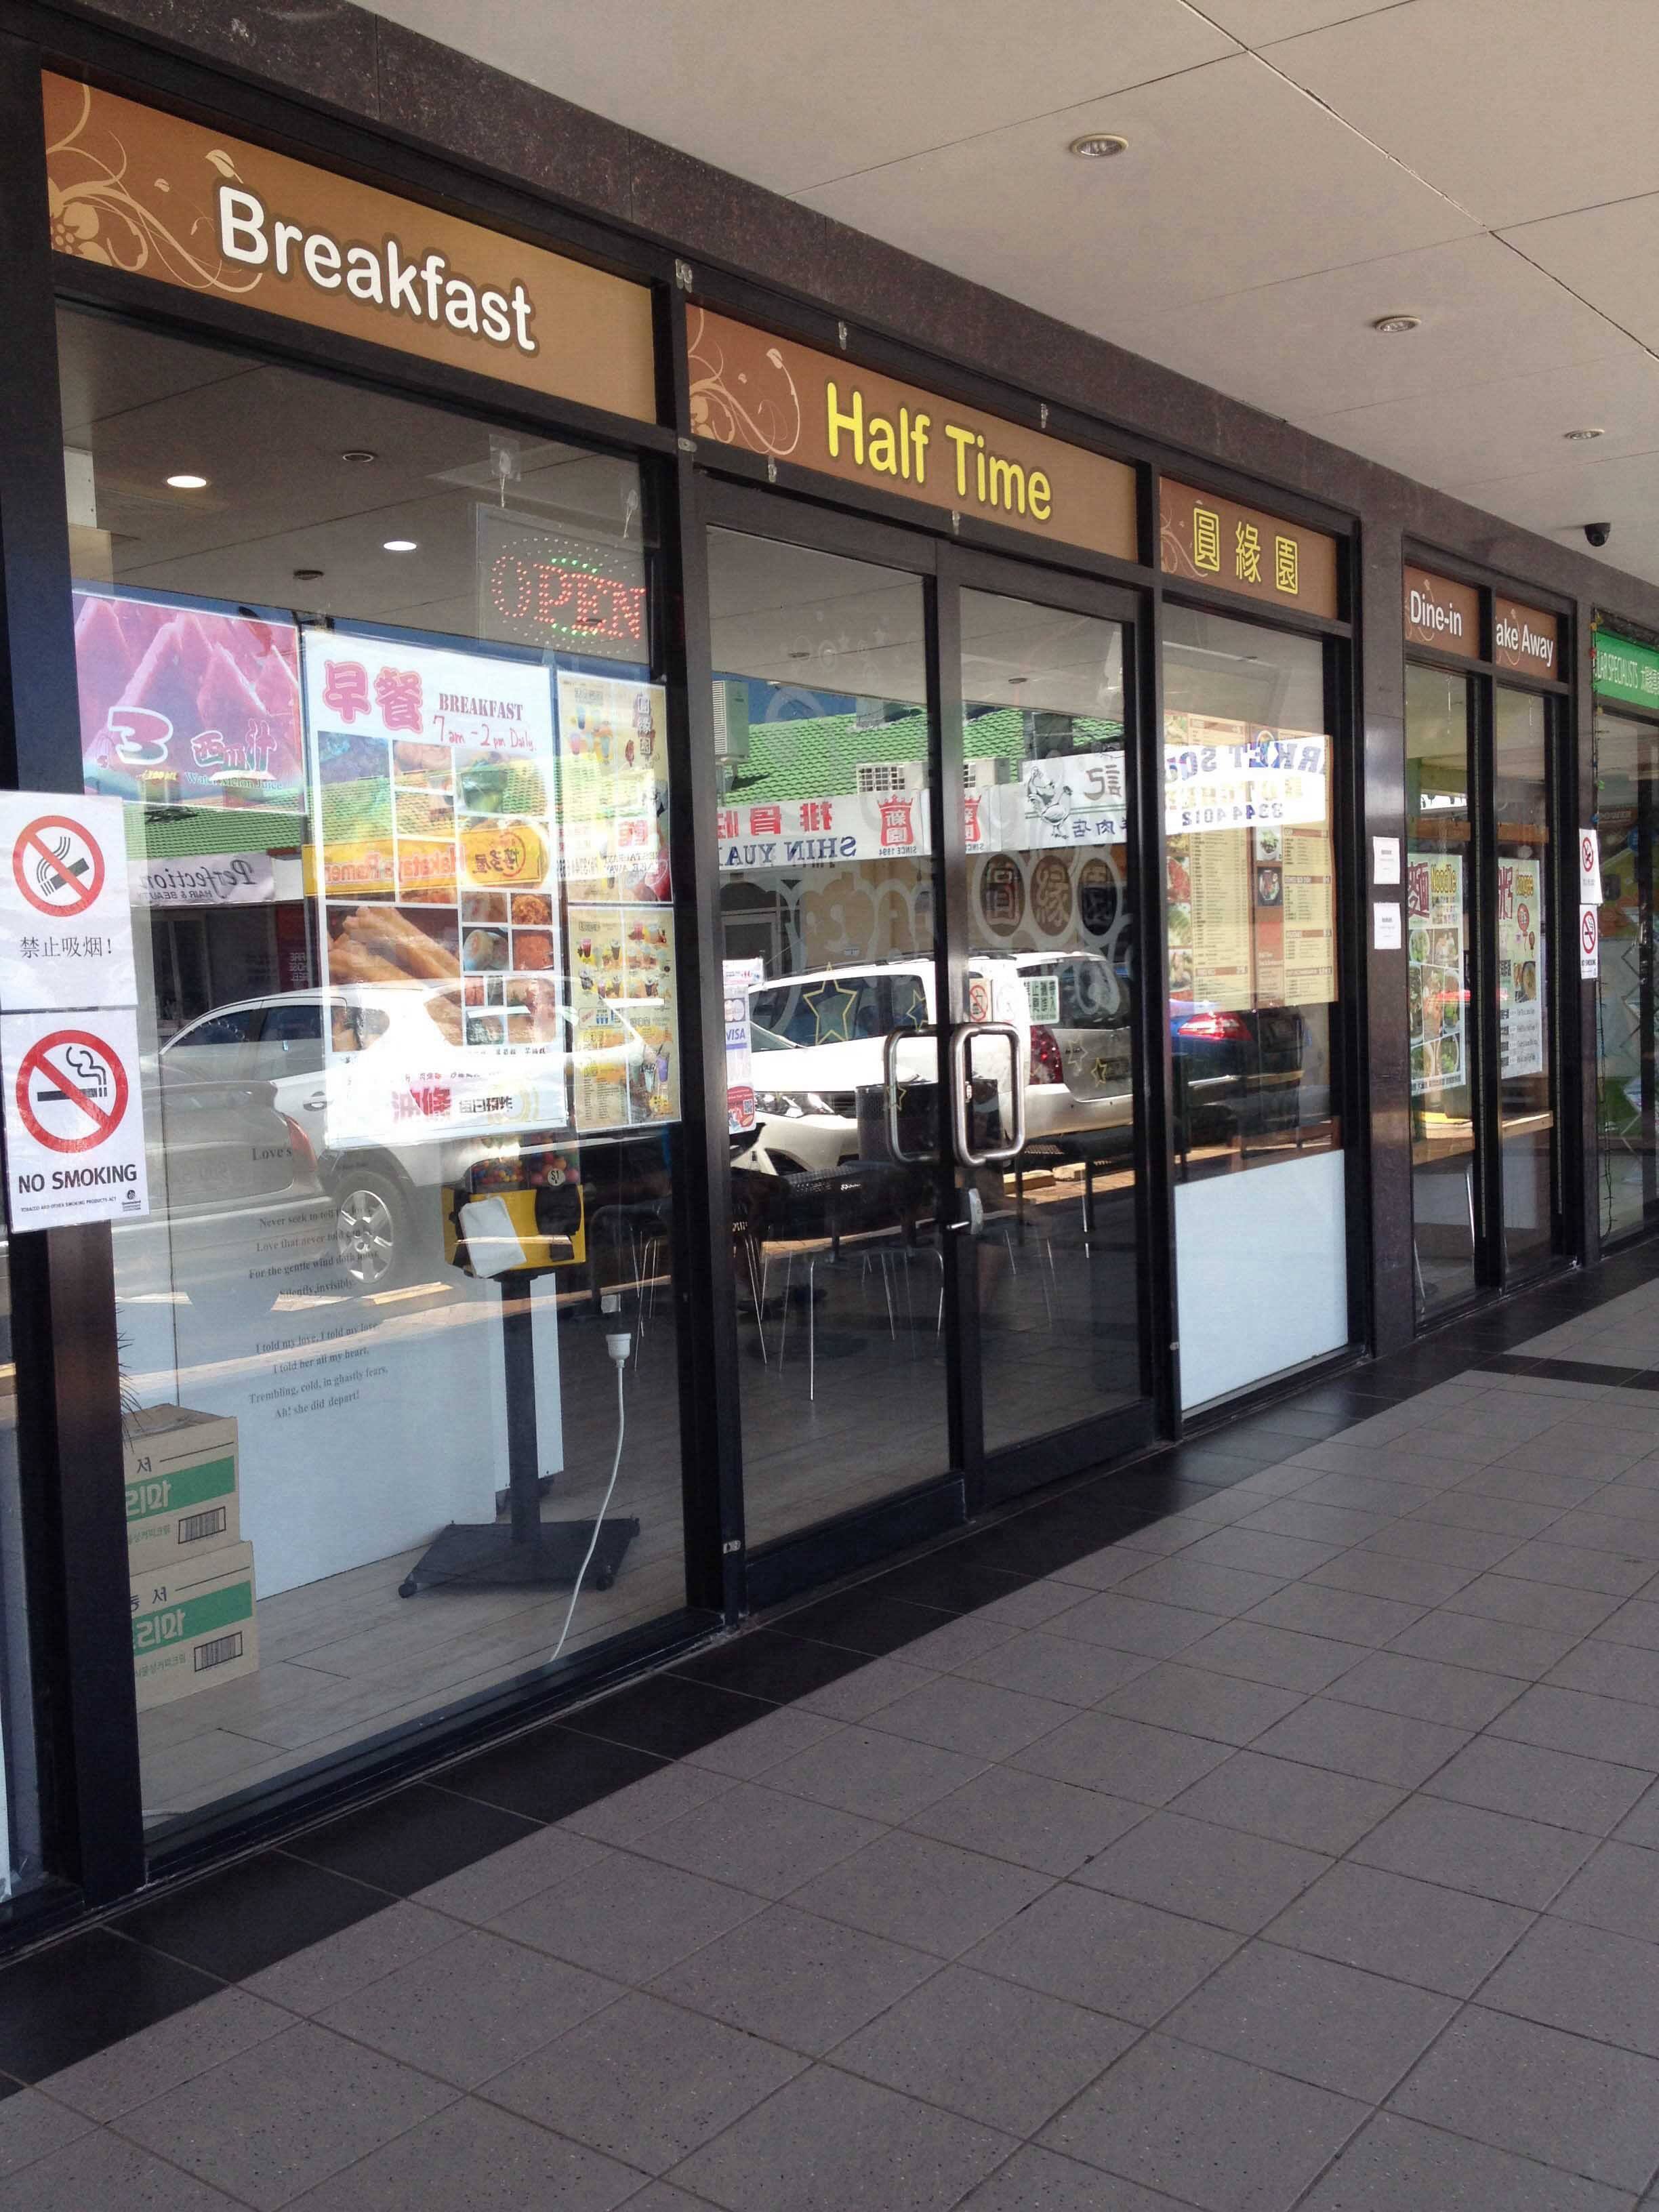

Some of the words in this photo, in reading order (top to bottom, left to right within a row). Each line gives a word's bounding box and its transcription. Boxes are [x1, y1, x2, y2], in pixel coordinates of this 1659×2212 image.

[218, 185, 536, 351] Breakfast
[827, 382, 931, 483] Half
[945, 424, 1052, 520] Time
[1193, 507, 1299, 595] 圓緣園
[491, 554, 646, 639] OPEN
[1410, 590, 1462, 637] Dine-in
[1495, 617, 1519, 651] ake
[1521, 624, 1554, 667] Away
[322, 659, 424, 734] 早餐
[438, 692, 524, 722] BREAKFAST
[220, 777, 255, 788] Melon
[256, 779, 283, 790] Juice
[1431, 863, 1456, 893] Noodle
[726, 1027, 745, 1041] VISA
[18, 1174, 45, 1194] NO
[52, 1164, 138, 1190] SMOKING
[259, 1217, 286, 1230] Never
[256, 1241, 279, 1252] Love
[281, 1237, 299, 1249] that
[302, 1234, 326, 1246] never
[249, 1267, 266, 1279] For
[268, 1263, 283, 1275] the
[283, 1259, 310, 1275] gentle
[312, 1255, 334, 1268] wind
[262, 1340, 281, 1353] told
[282, 1339, 295, 1351] my
[327, 1327, 344, 1339] told
[346, 1326, 358, 1336] my
[279, 1360, 298, 1372] told
[299, 1357, 314, 1368] her
[316, 1354, 328, 1365] all
[329, 1351, 344, 1364] my
[249, 1386, 299, 1404] Trembling,
[323, 1377, 332, 1387] in
[333, 1370, 364, 1387] ghastly
[274, 1407, 292, 1420] Ah!
[293, 1402, 308, 1415] she
[310, 1397, 325, 1411] did
[328, 1389, 360, 1408] depart!
[136, 1456, 152, 1474] 서
